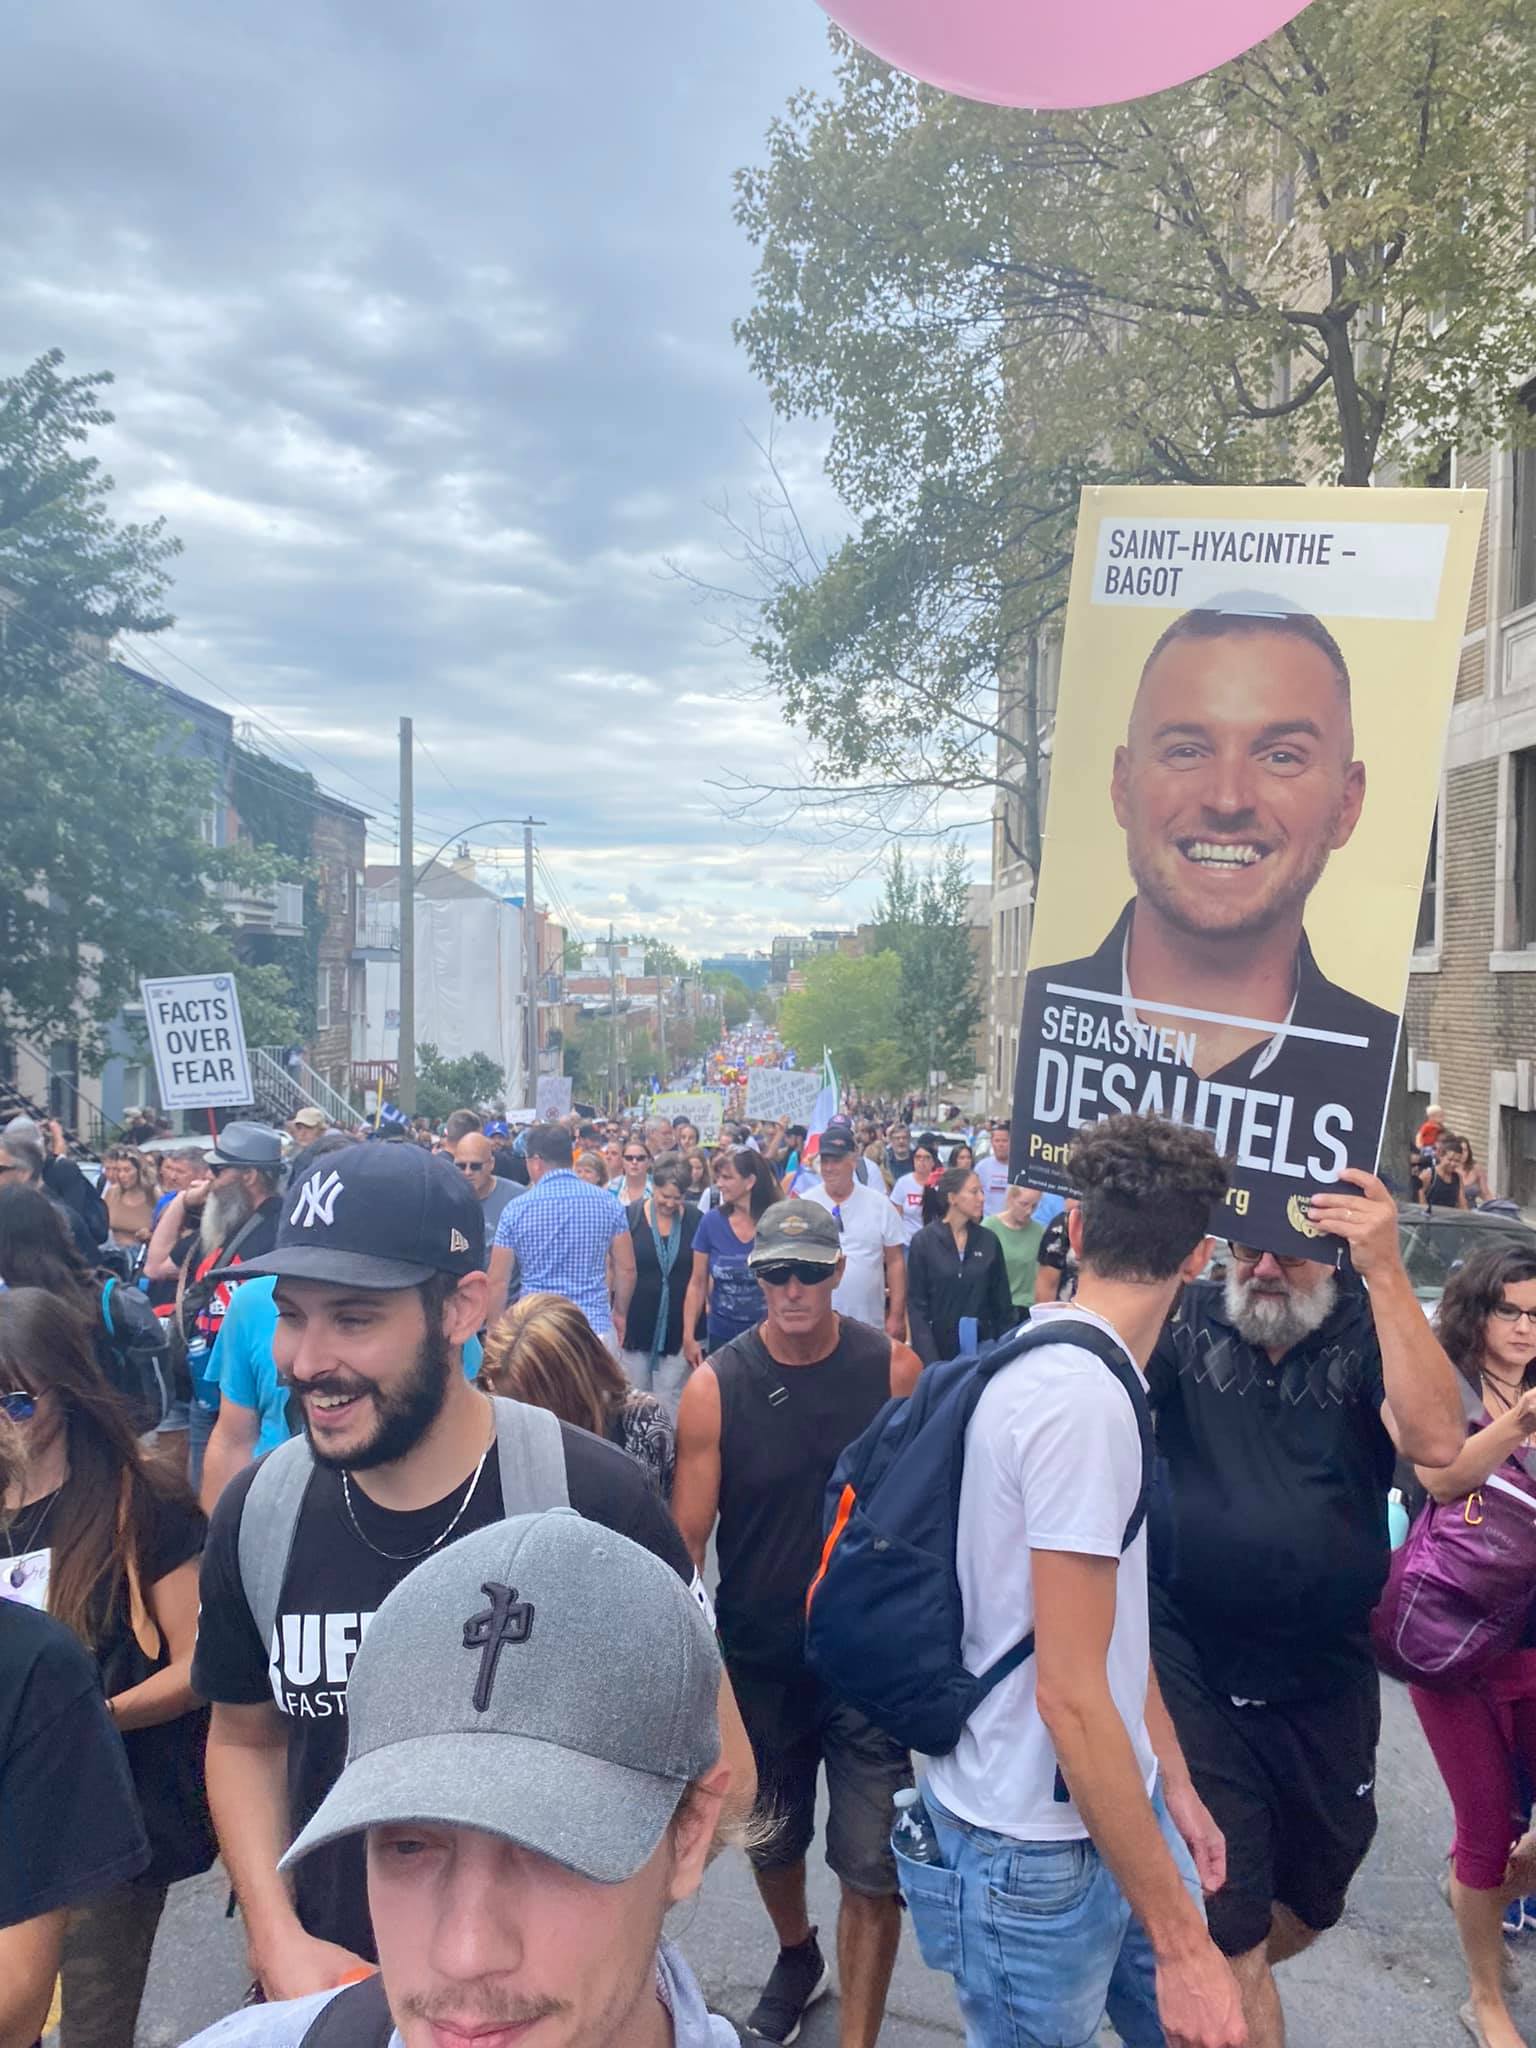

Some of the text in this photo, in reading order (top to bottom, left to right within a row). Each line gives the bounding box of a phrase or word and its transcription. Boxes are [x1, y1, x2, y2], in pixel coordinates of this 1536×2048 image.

[1108, 529, 1335, 566] SAINT-HYACINTHE
[1104, 566, 1184, 597] BAGOT
[158, 998, 228, 1024] FACTS
[166, 1028, 231, 1054] OVER
[172, 1058, 235, 1084] FEAR
[1033, 1048, 1354, 1184] DESAUTELS
[290, 1170, 345, 1227] NY
[269, 1612, 377, 1712] UF
